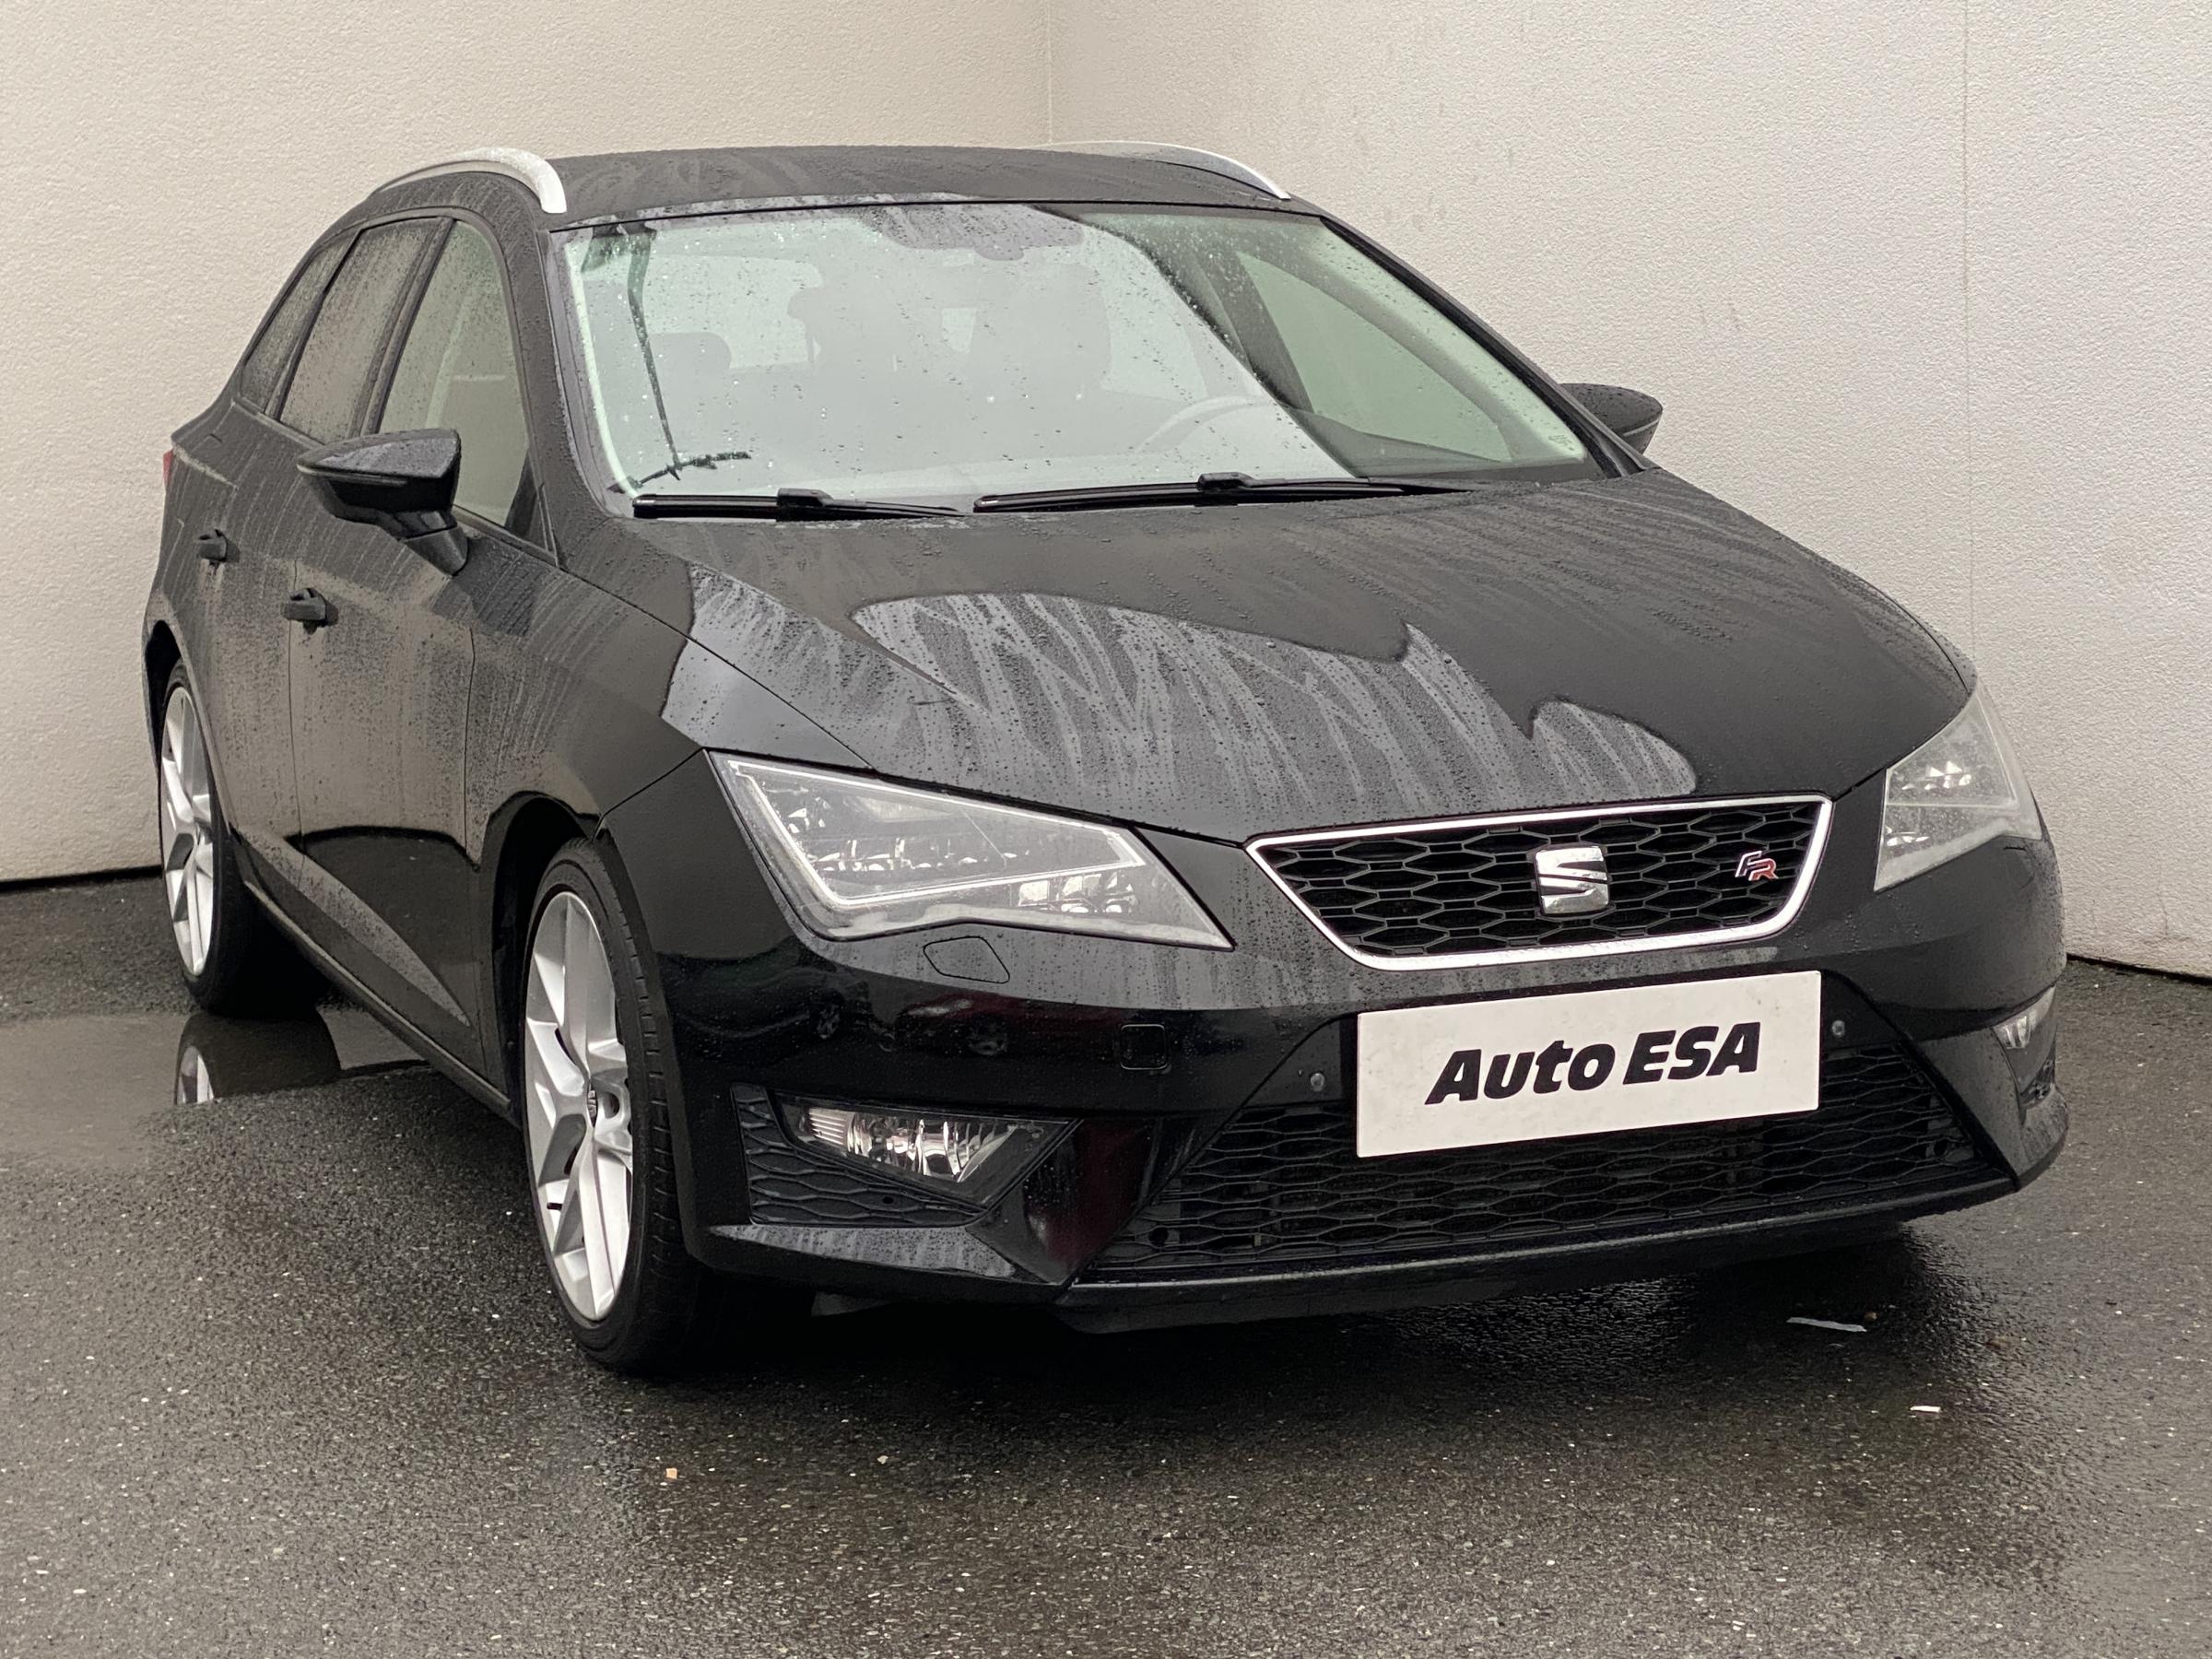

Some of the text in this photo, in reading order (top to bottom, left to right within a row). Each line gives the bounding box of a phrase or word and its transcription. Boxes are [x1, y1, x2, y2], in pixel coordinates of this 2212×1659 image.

[1735, 850, 1779, 881] FR
[1424, 1021, 1761, 1106] Auto ESA
